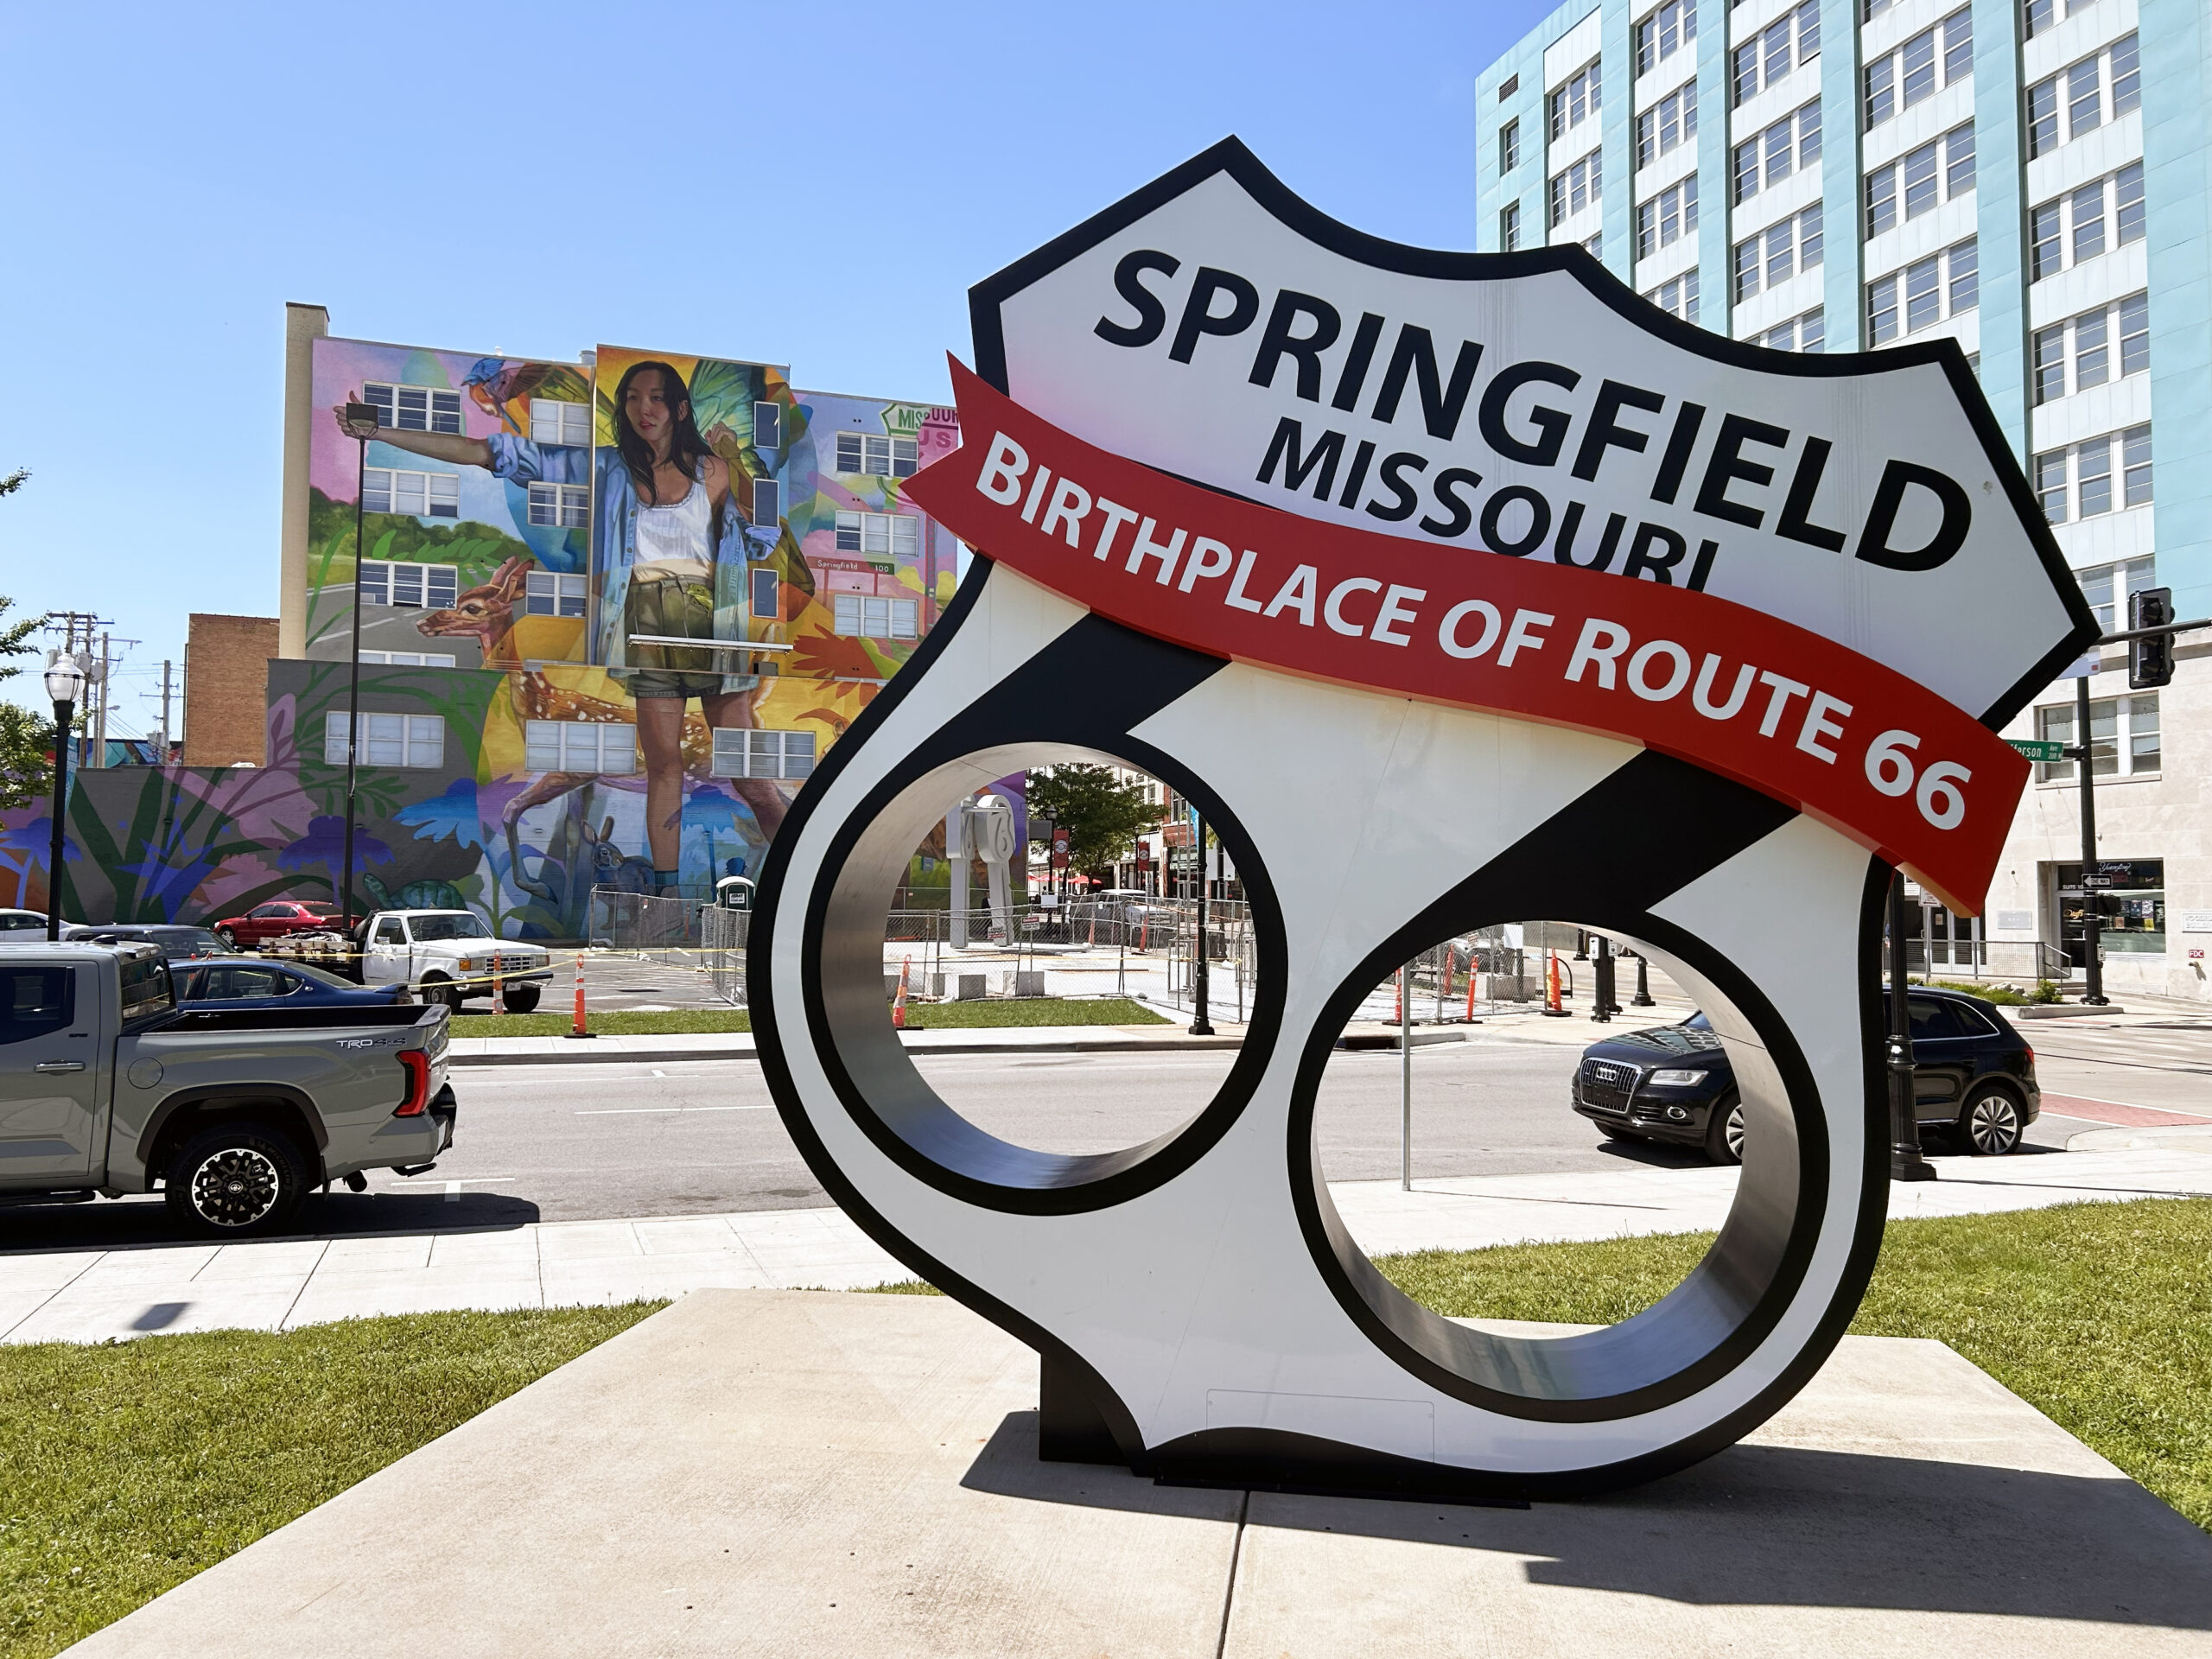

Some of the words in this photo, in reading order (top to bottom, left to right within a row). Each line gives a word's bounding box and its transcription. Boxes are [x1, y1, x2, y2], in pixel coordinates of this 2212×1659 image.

[1094, 250, 1972, 571] SPRINGFIELD
[817, 560, 858, 570] Springfield
[1255, 416, 1719, 593] MISSOURI
[976, 430, 1427, 646] BIRTHPLACE
[1439, 600, 1554, 667] OF
[1567, 619, 1853, 765] ROUTE
[1864, 730, 1972, 830] 66
[336, 1039, 372, 1049] TRD
